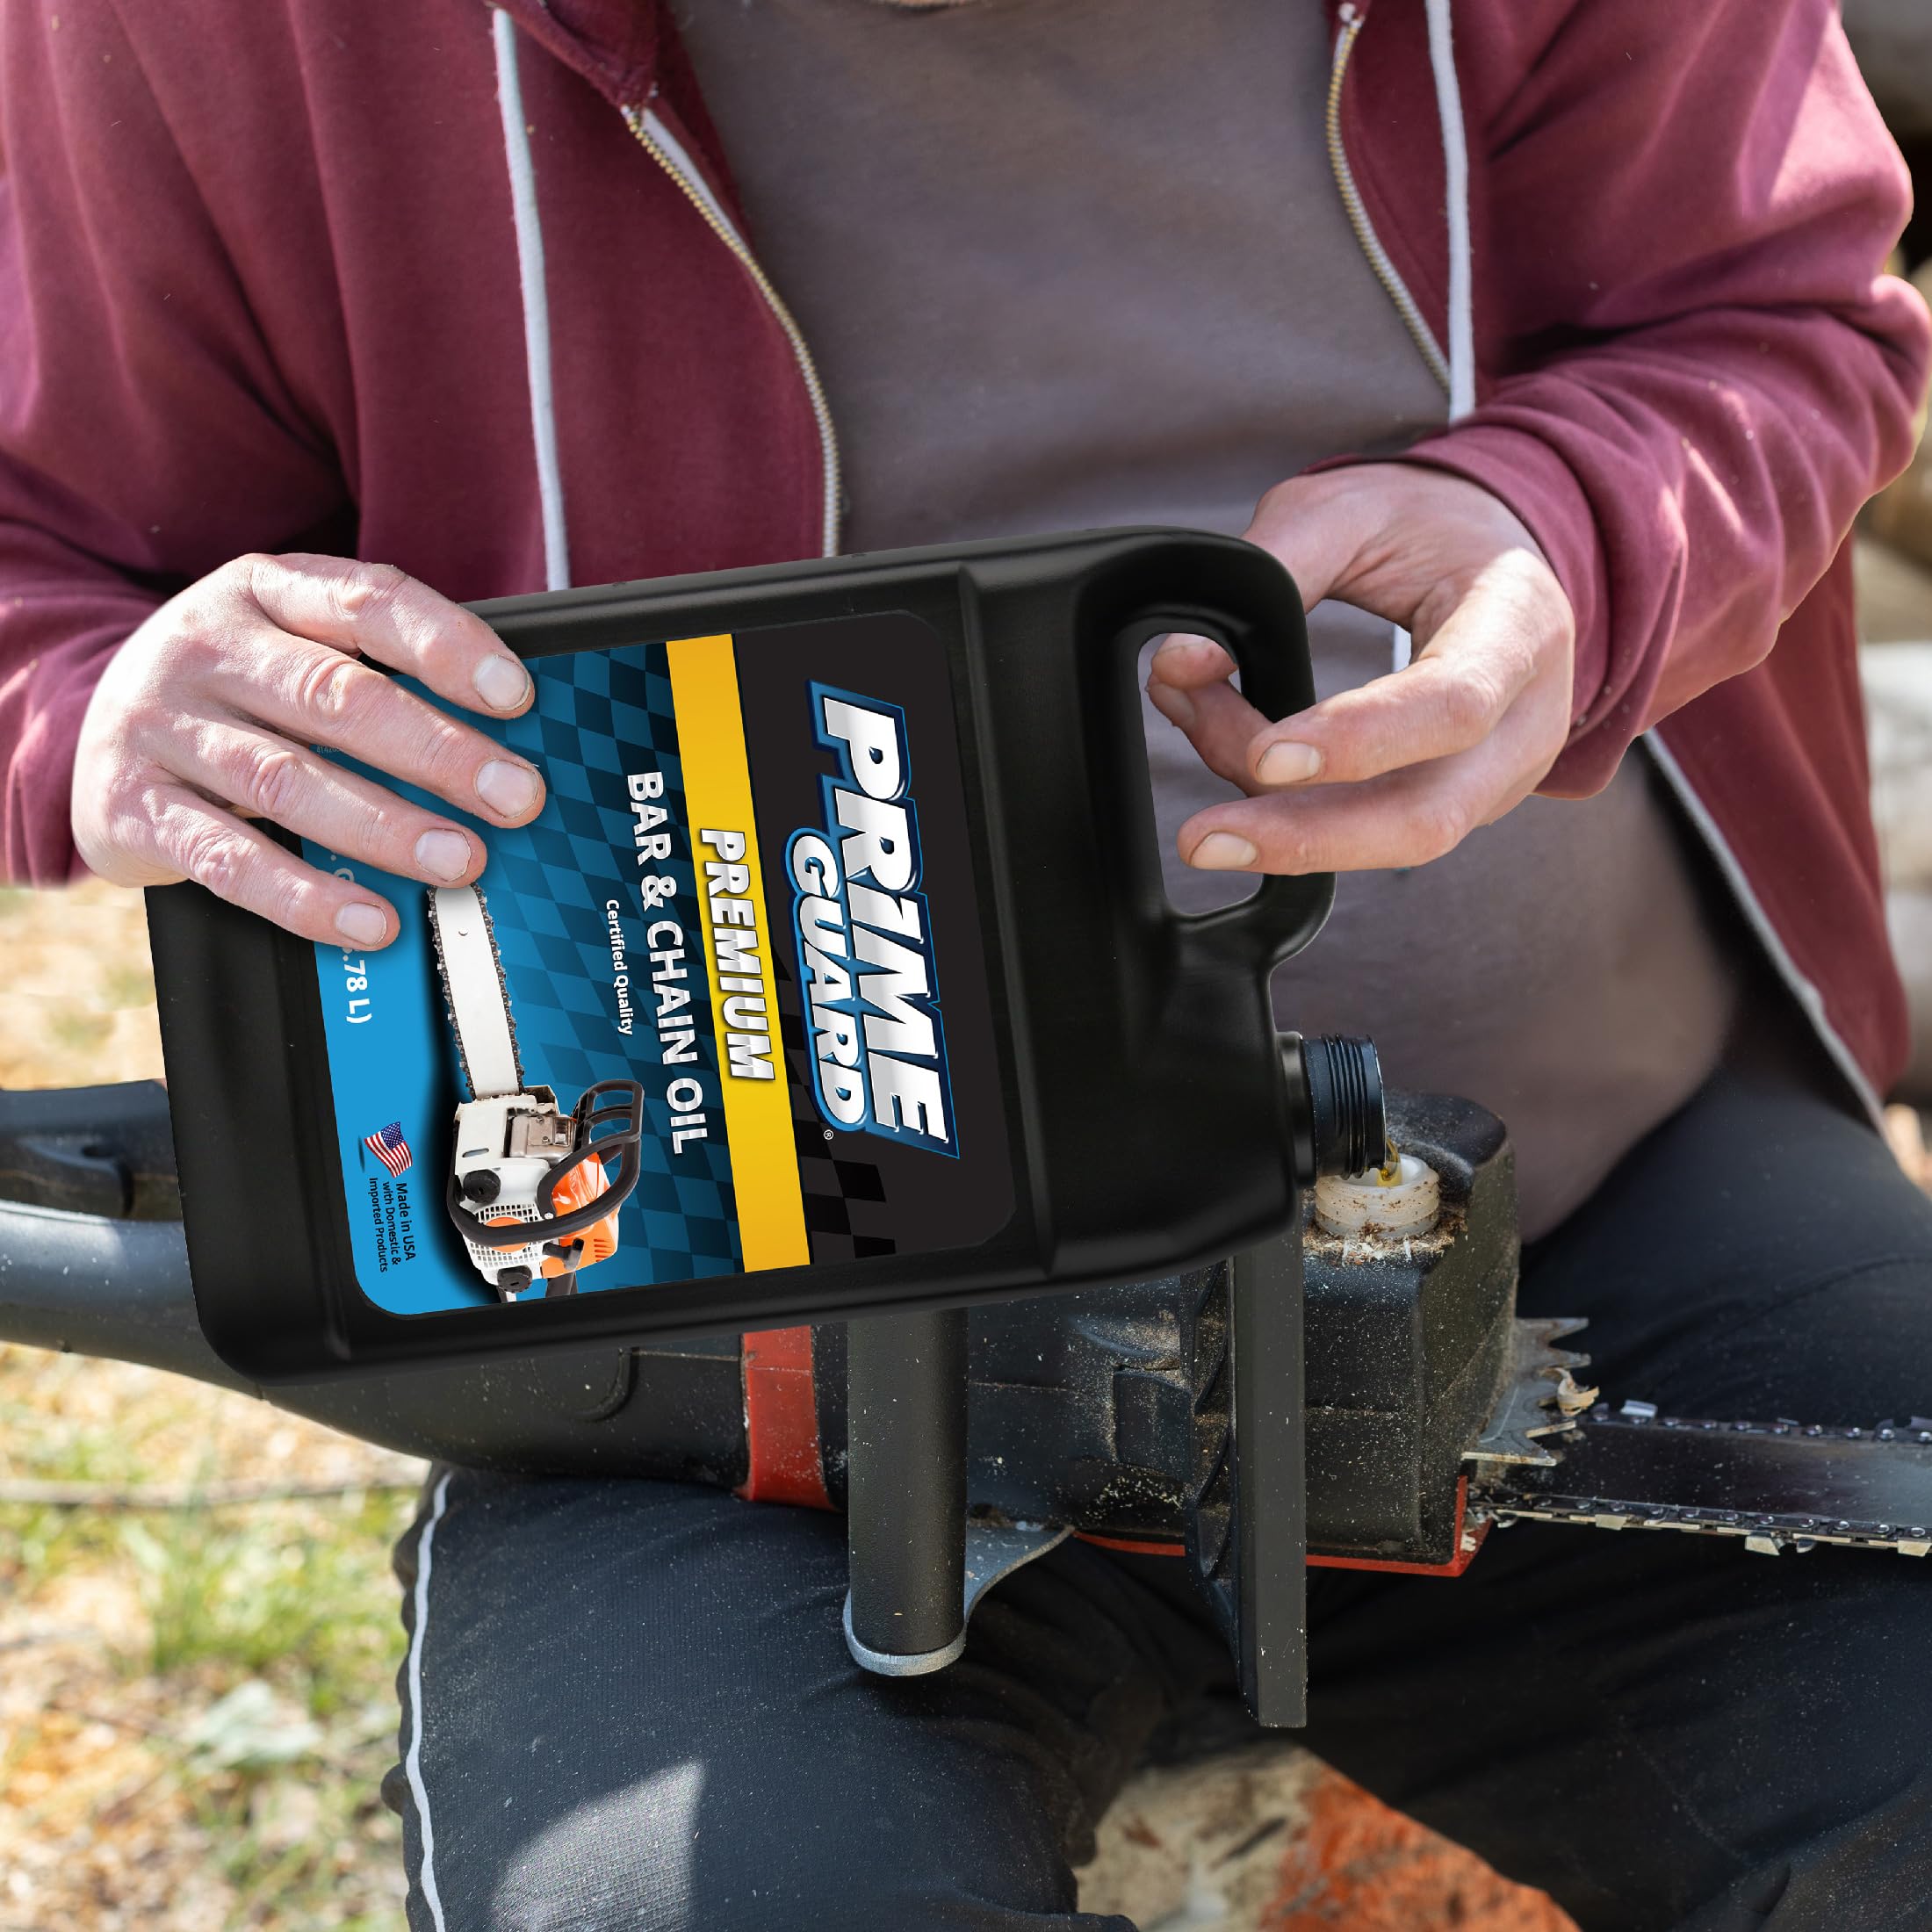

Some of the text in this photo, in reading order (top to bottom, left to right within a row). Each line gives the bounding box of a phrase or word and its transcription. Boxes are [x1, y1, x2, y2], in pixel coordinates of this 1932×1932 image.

[342, 948, 372, 1024] .78 L)
[606, 899, 634, 1035] Certified Quality
[627, 771, 709, 1155] BAR & CHAIN OIL
[700, 827, 775, 1081] PREMIUM
[792, 833, 865, 1125] GUARD
[823, 696, 949, 1143] PRIME
[367, 1177, 388, 1273] Imported Products
[382, 1181, 401, 1265] with Domestic &
[396, 1183, 416, 1261] Made in USA
